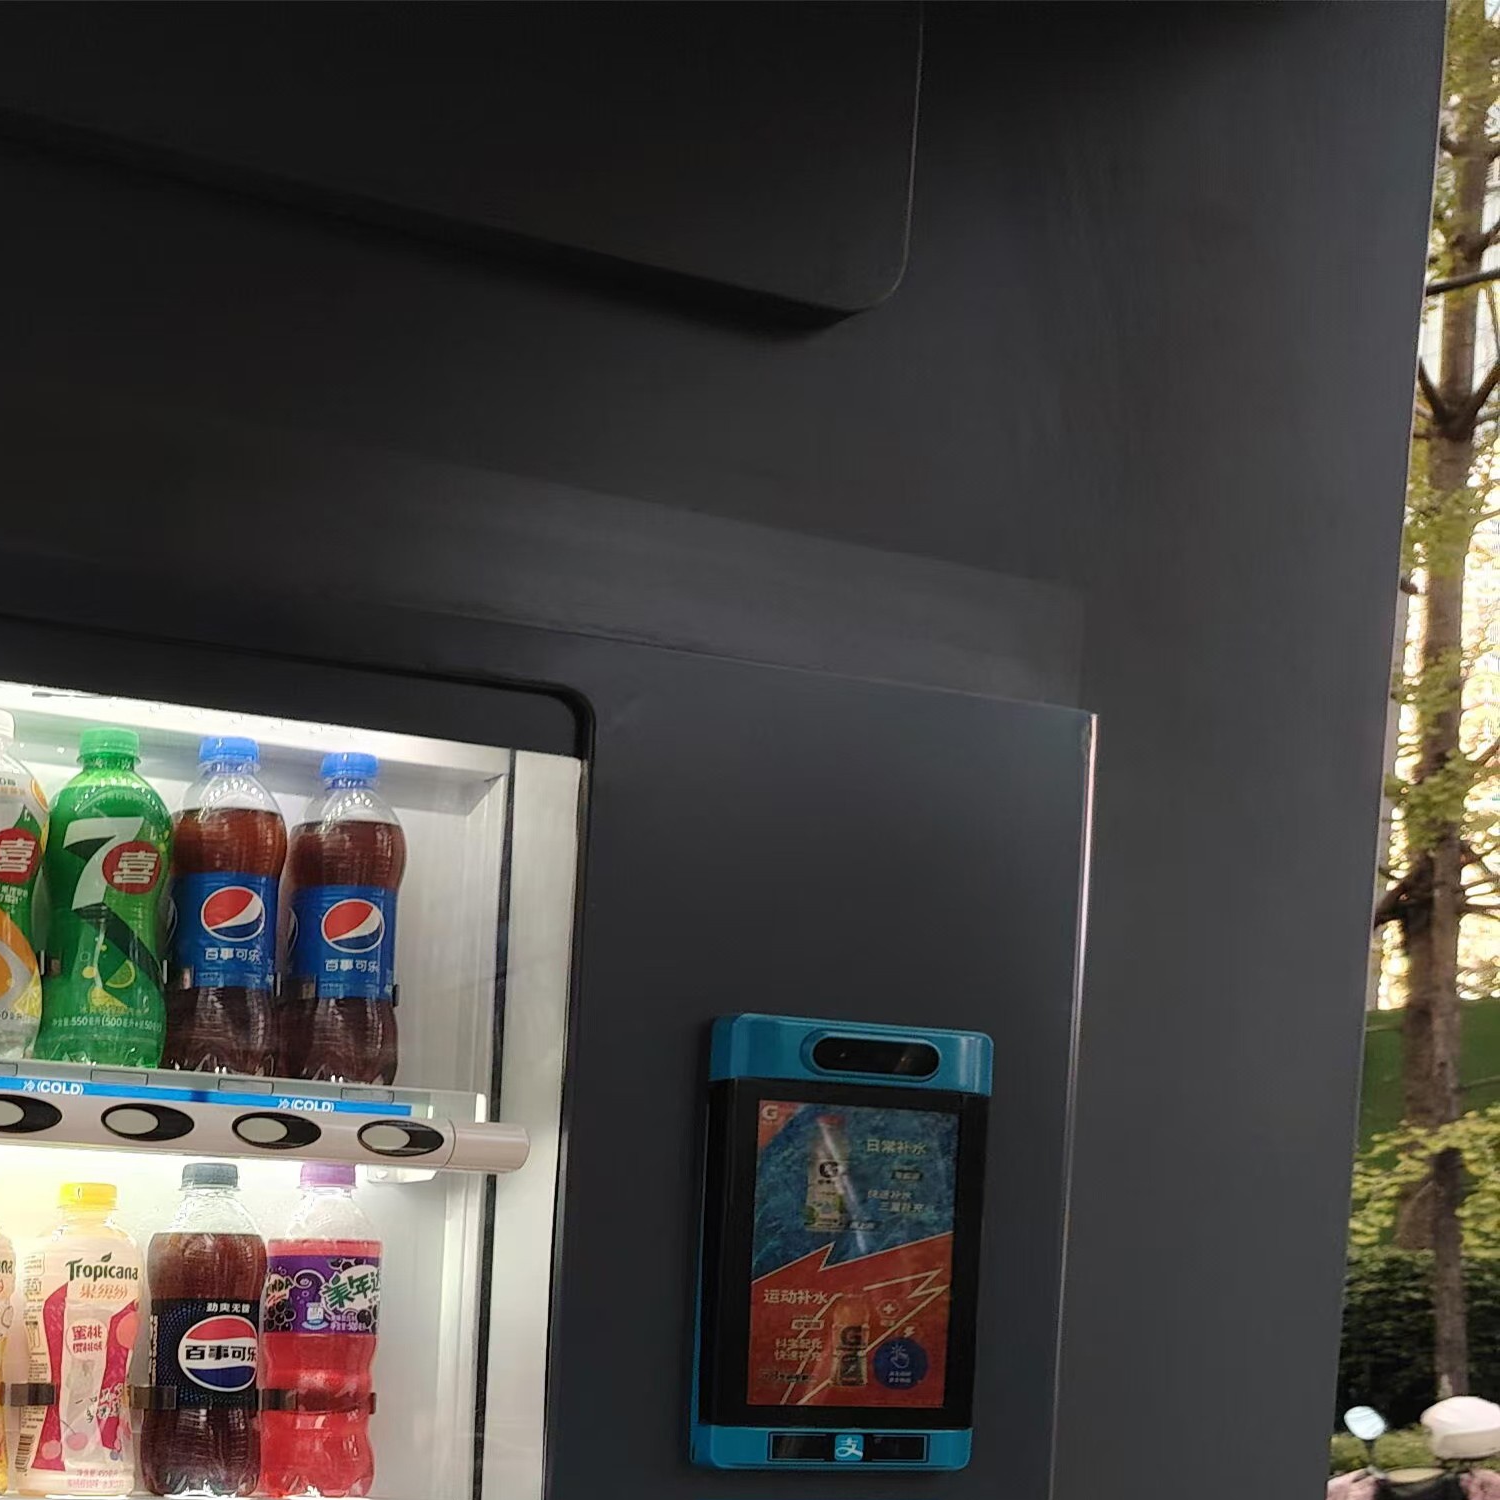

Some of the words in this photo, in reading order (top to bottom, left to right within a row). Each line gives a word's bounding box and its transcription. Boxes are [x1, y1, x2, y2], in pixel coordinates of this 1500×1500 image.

[204, 948, 262, 963] 百事可乐
[324, 959, 380, 973] 百事可乐
[66, 1257, 138, 1282] Tropicana
[72, 1325, 103, 1341] 蜜桃
